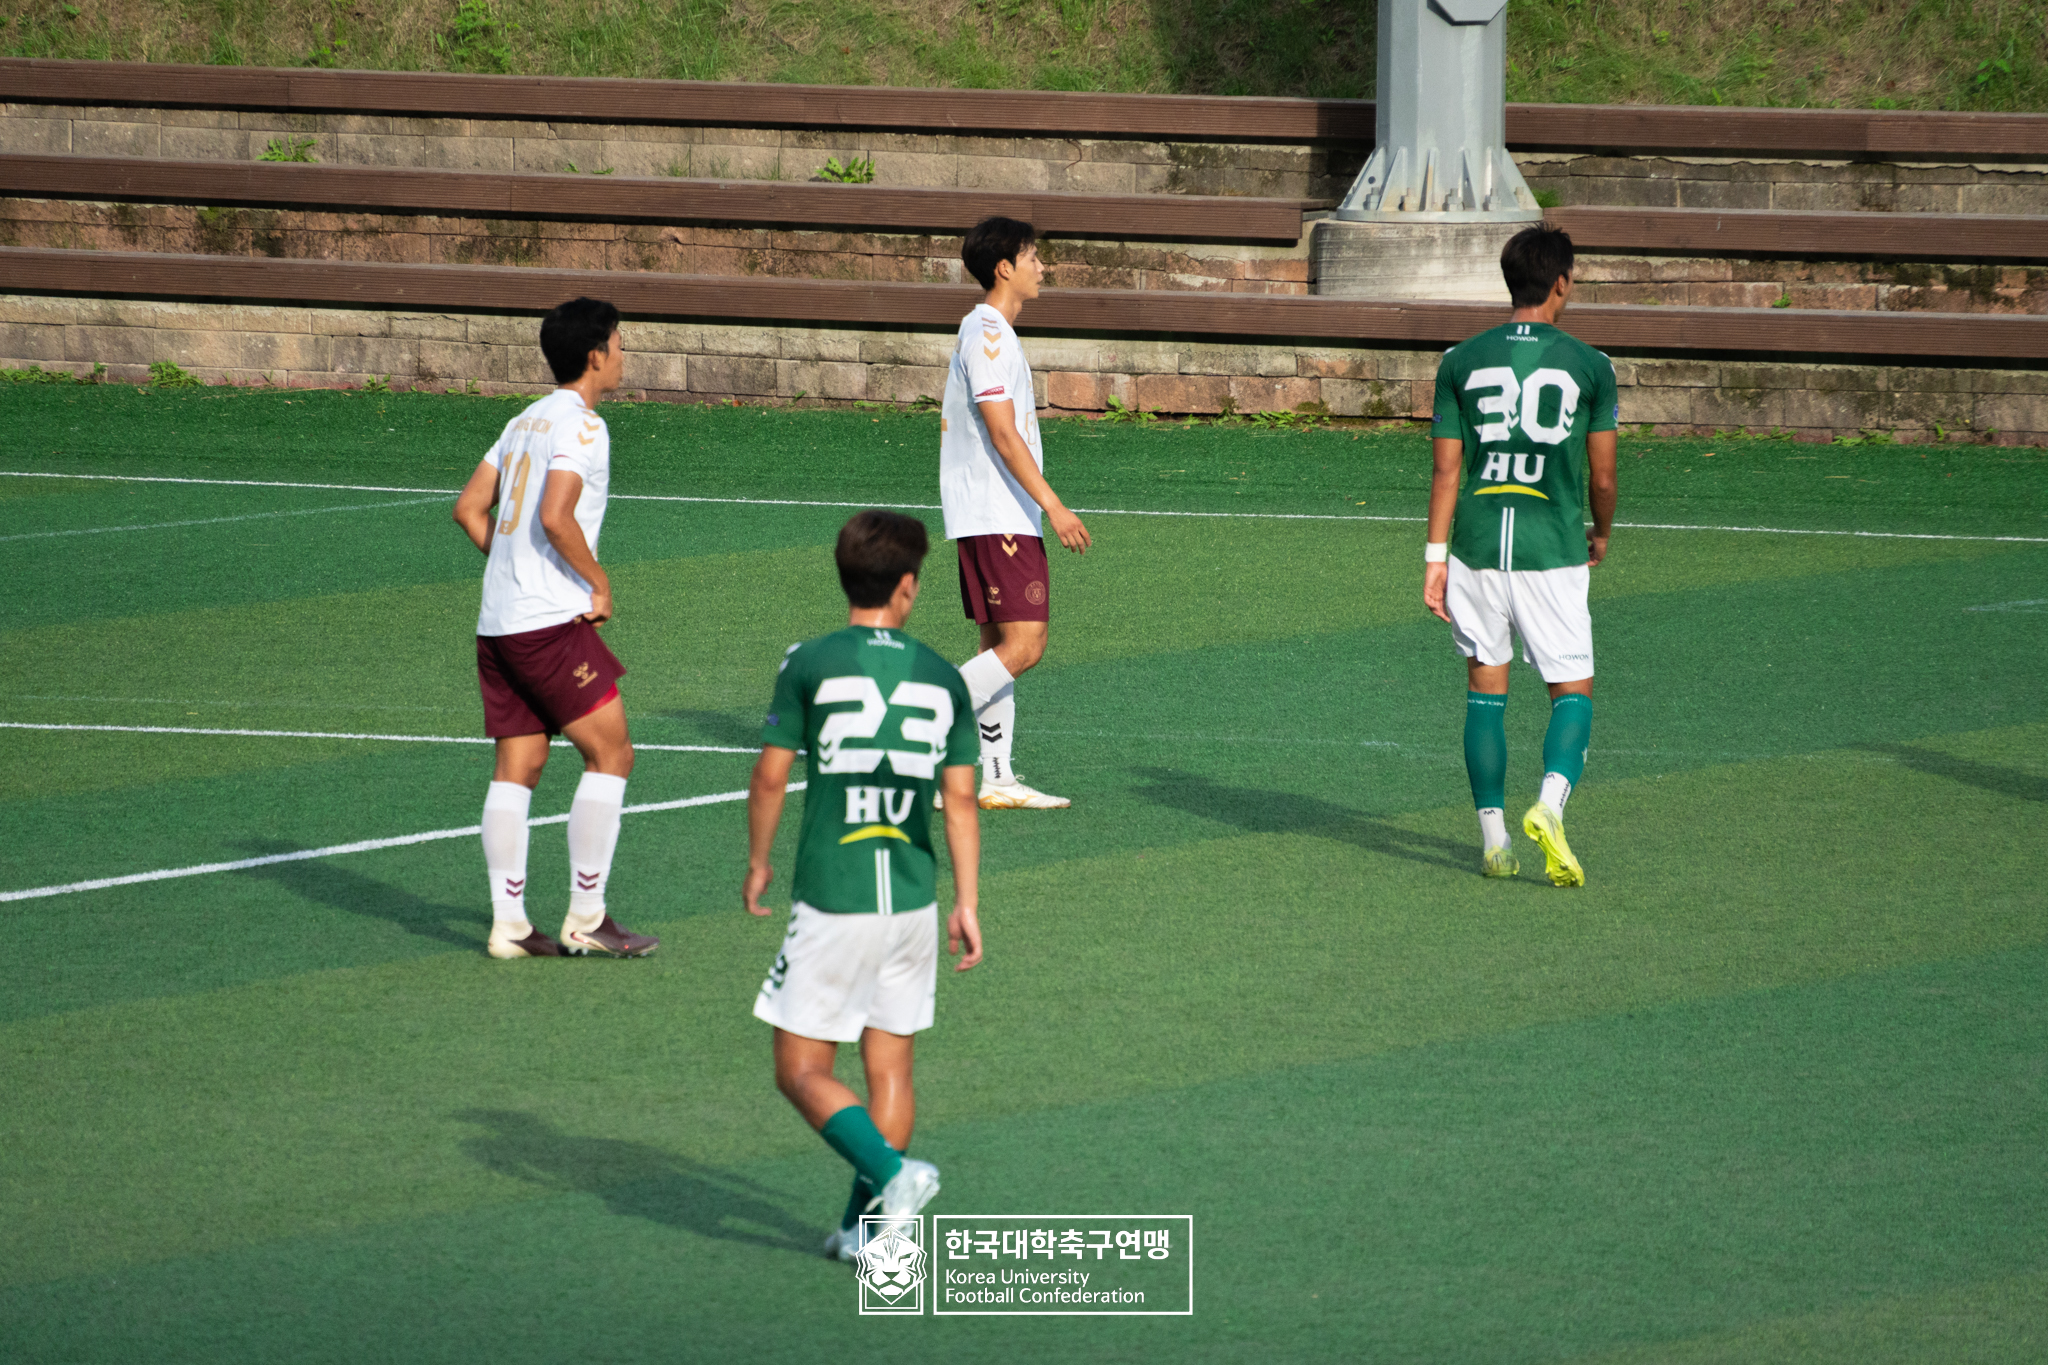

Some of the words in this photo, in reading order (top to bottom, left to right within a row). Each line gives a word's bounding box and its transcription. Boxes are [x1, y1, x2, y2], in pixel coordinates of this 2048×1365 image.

[1506, 335, 1539, 343] HOWON
[1464, 366, 1581, 445] 30
[1481, 451, 1547, 484] HU
[813, 675, 955, 780] 23
[844, 785, 917, 825] HU
